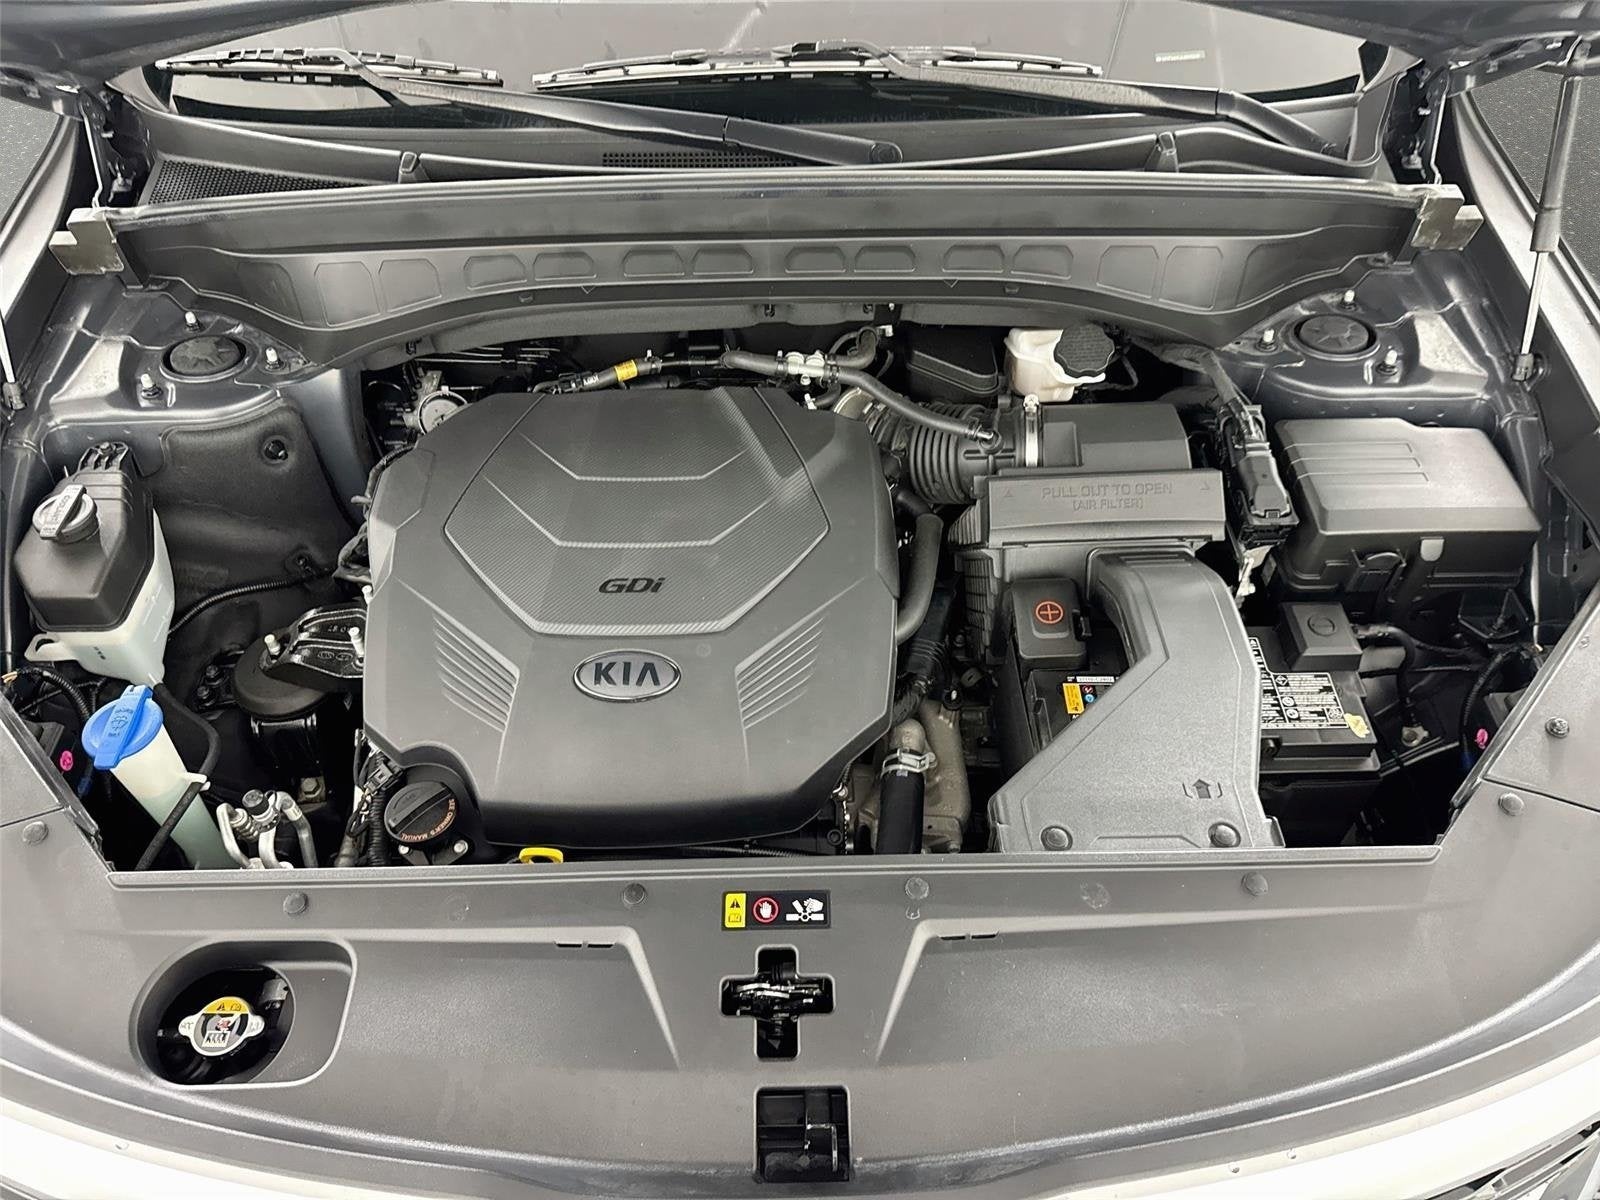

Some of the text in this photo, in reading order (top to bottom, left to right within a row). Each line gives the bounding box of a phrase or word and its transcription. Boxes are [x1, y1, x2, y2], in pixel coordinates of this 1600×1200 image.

[1042, 482, 1173, 499] PULL OUT TO OPEN
[599, 577, 665, 593] GDi
[594, 661, 661, 686] KIA
[401, 798, 456, 841] SEE OWNER'S MANUAL
